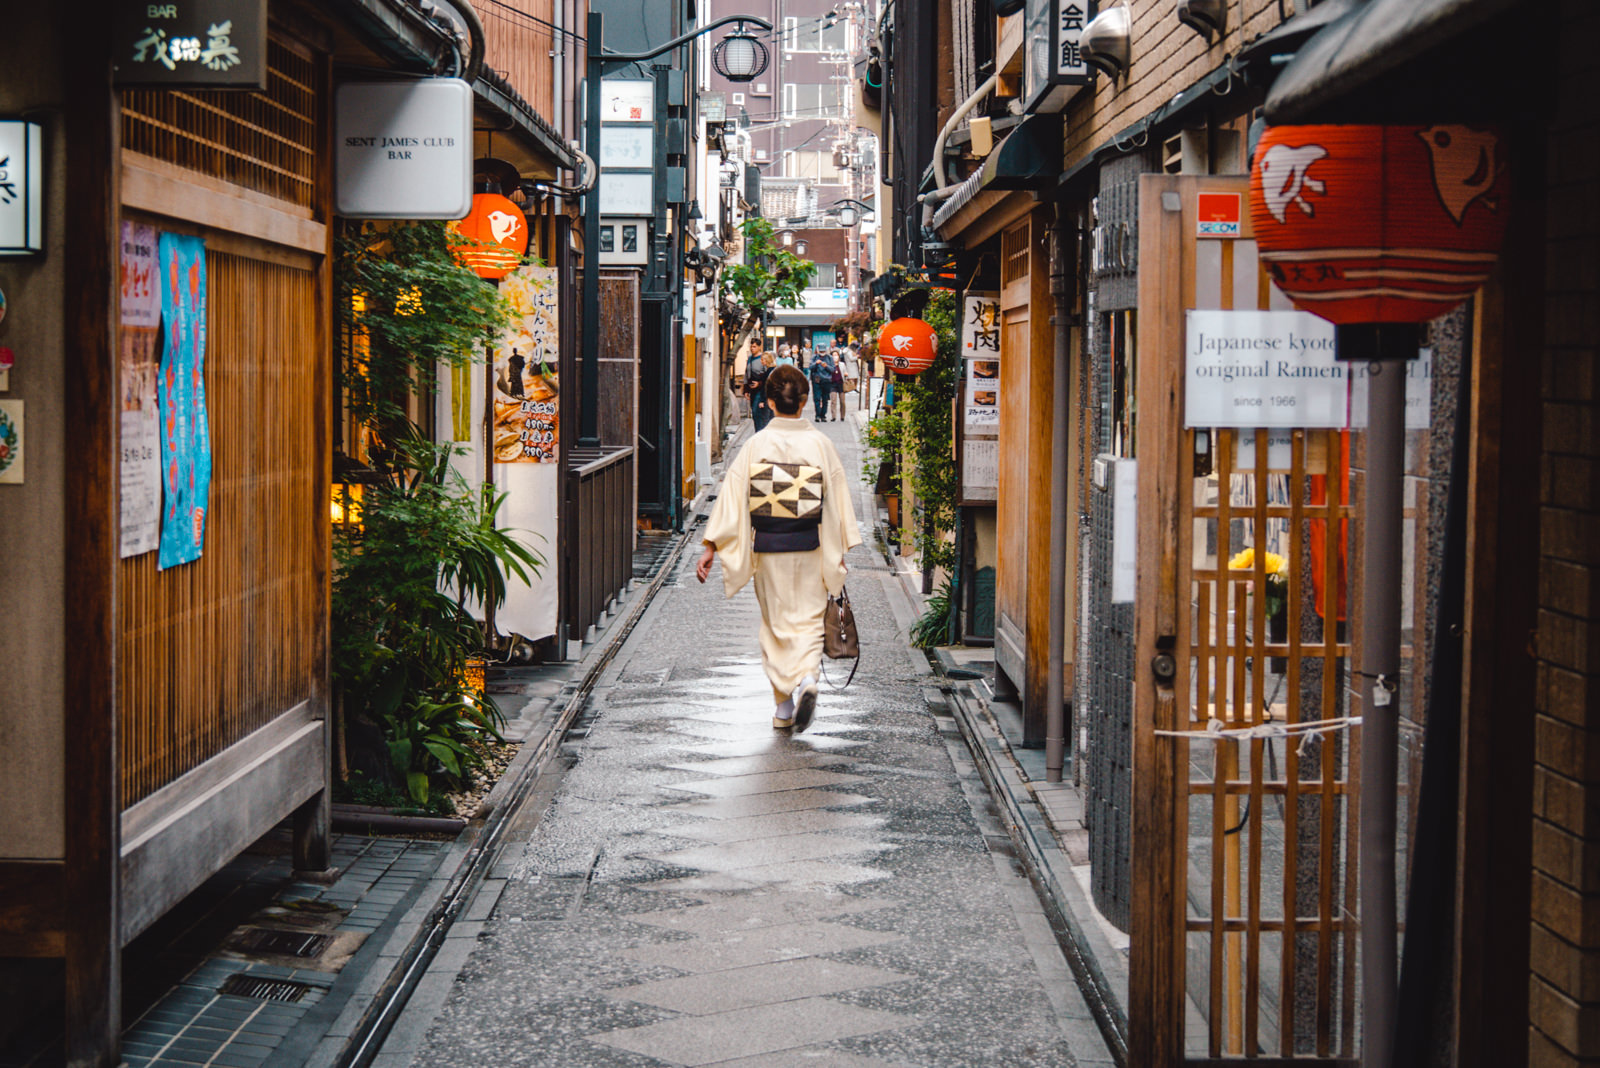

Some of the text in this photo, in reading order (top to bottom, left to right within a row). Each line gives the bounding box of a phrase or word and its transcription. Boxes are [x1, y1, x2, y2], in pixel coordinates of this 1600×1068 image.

[147, 5, 177, 18] BAR
[1061, 4, 1083, 67] 会館
[345, 137, 455, 148] SENT JAMES CLUB
[388, 150, 412, 160] BAR
[1200, 223, 1237, 233] SECOM
[970, 300, 1000, 352] 焼肉
[1194, 332, 1282, 355] Japanese
[1196, 360, 1269, 382] original
[1278, 360, 1342, 378] Ramen
[1234, 396, 1296, 407] since 1966
